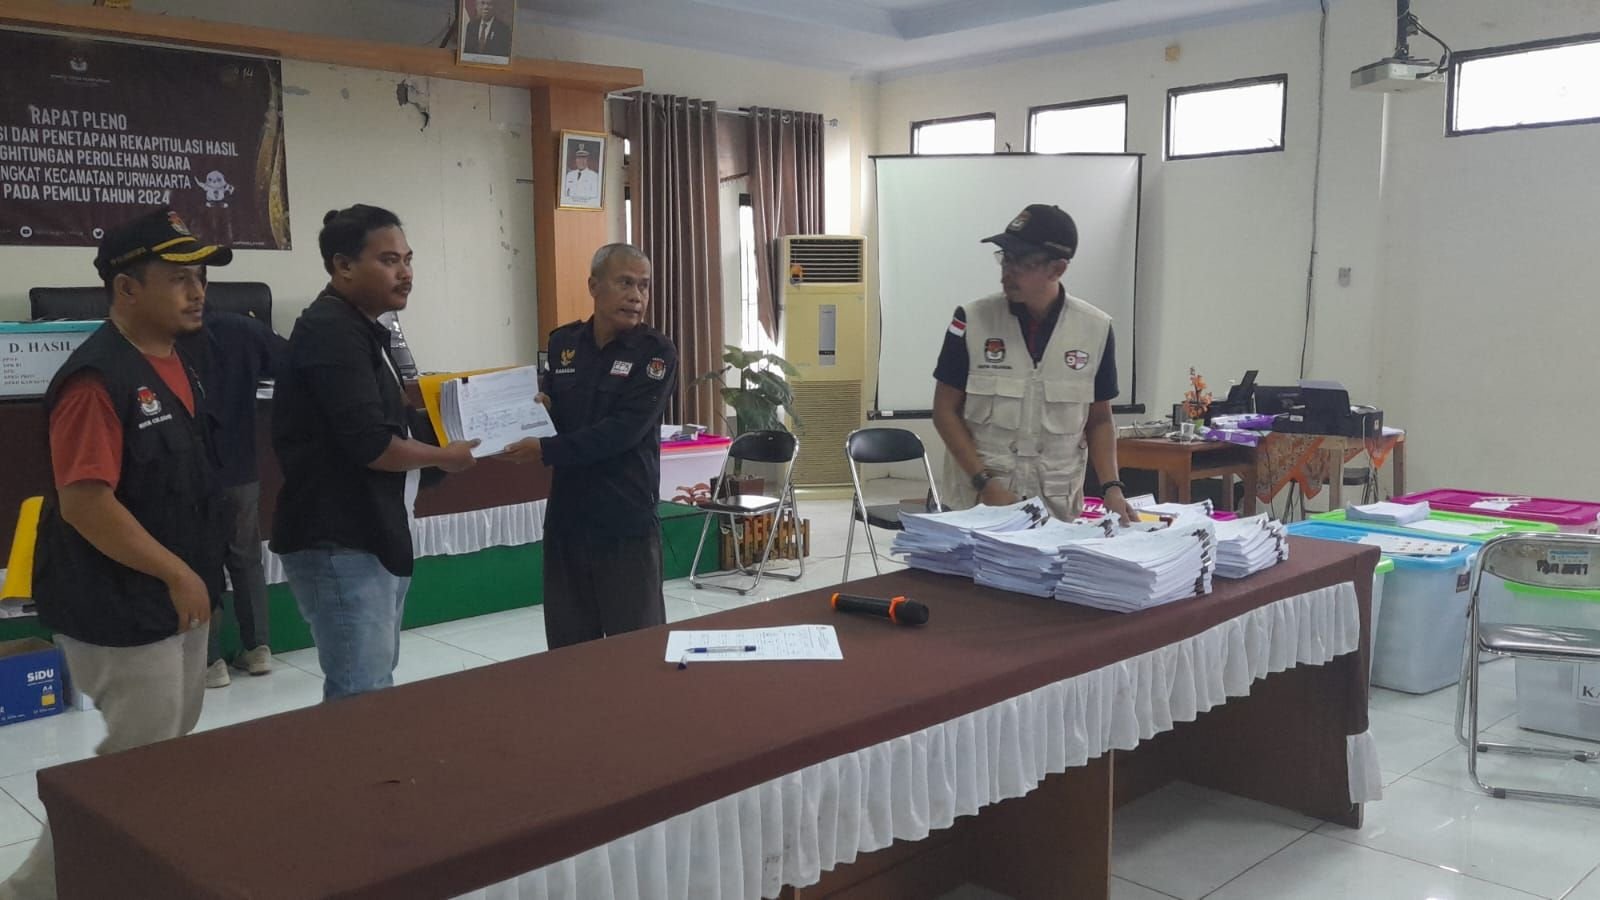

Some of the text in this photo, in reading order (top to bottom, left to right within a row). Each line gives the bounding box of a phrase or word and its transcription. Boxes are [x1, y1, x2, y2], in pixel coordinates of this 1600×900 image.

[31, 106, 127, 131] RAPAT PLENO
[11, 126, 39, 143] DAN
[42, 129, 116, 148] PENETAPAN
[119, 134, 203, 155] REKAPITULASI
[205, 140, 239, 157] HASIL
[0, 144, 191, 171] GHITUNGAN PEROLEHAN SUARA
[0, 164, 192, 190] NGKAT KECAMATAN PURWAKARTA
[3, 183, 172, 205] PADA PEMILU TAHUN 2024
[9, 342, 24, 353] D.
